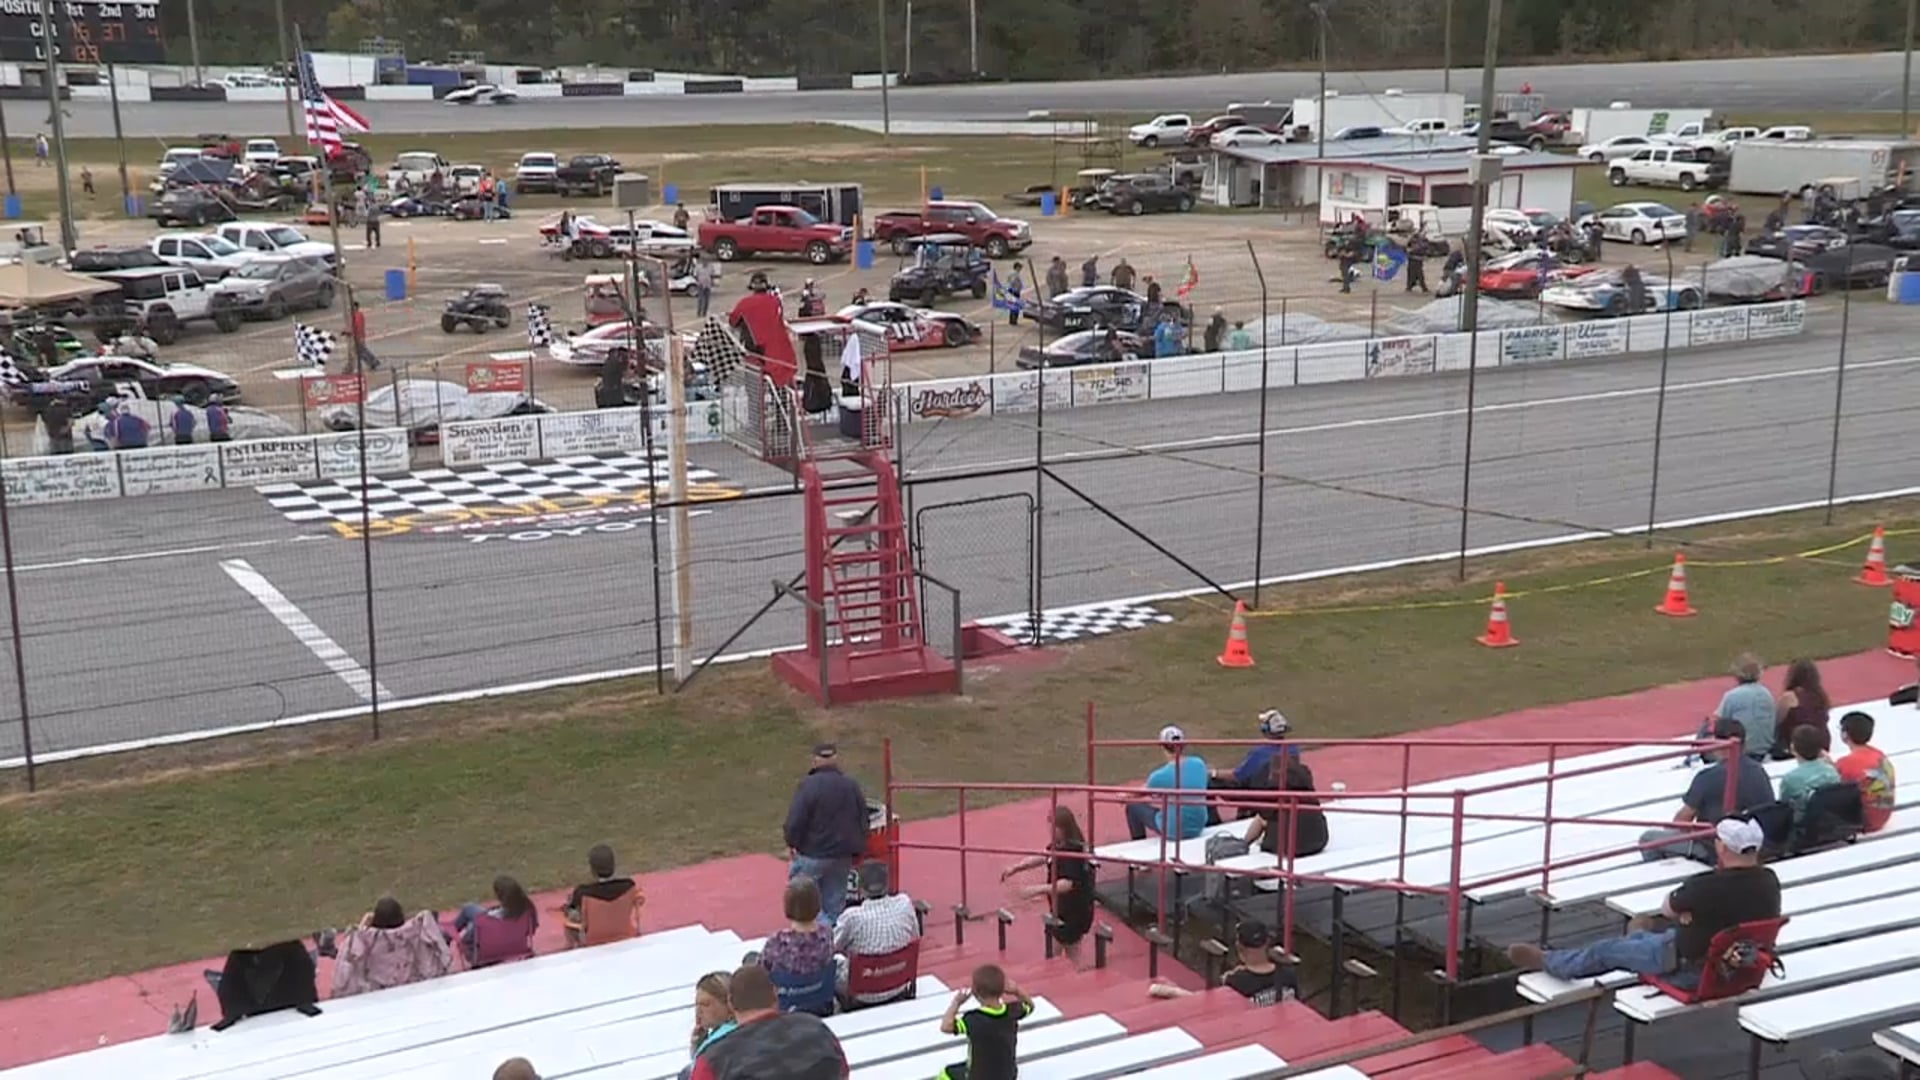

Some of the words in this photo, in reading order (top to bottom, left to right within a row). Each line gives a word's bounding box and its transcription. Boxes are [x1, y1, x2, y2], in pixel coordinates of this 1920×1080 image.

[0, 0, 54, 15] OSITI
[66, 4, 85, 16] 1st
[100, 5, 122, 17] 2nd
[136, 5, 155, 18] 3rd
[102, 23, 125, 41] 37
[35, 46, 60, 60] LP
[115, 382, 147, 401] 51
[911, 383, 986, 414] Hardee's
[226, 441, 312, 457] ENTERPRISE
